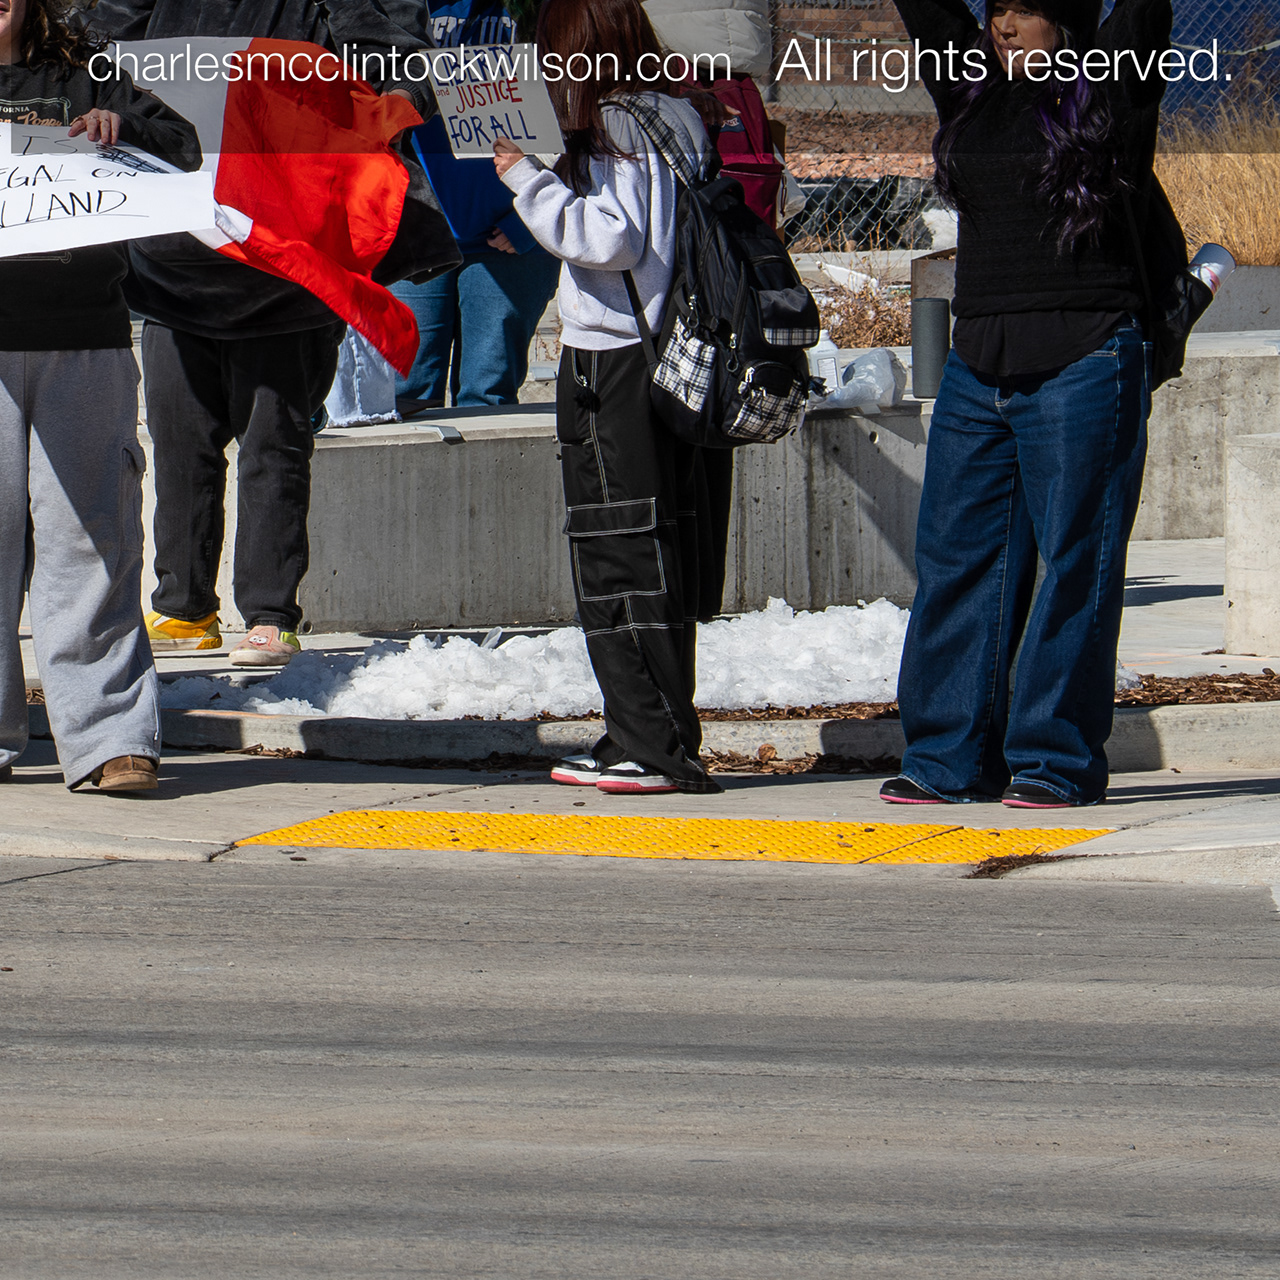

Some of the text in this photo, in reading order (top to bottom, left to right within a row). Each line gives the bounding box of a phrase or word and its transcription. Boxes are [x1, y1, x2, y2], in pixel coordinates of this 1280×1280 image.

[436, 77, 523, 113] and JUSTICE
[14, 135, 78, 157] IS
[448, 110, 537, 149] FOR ALL
[26, 189, 127, 223] LAND
